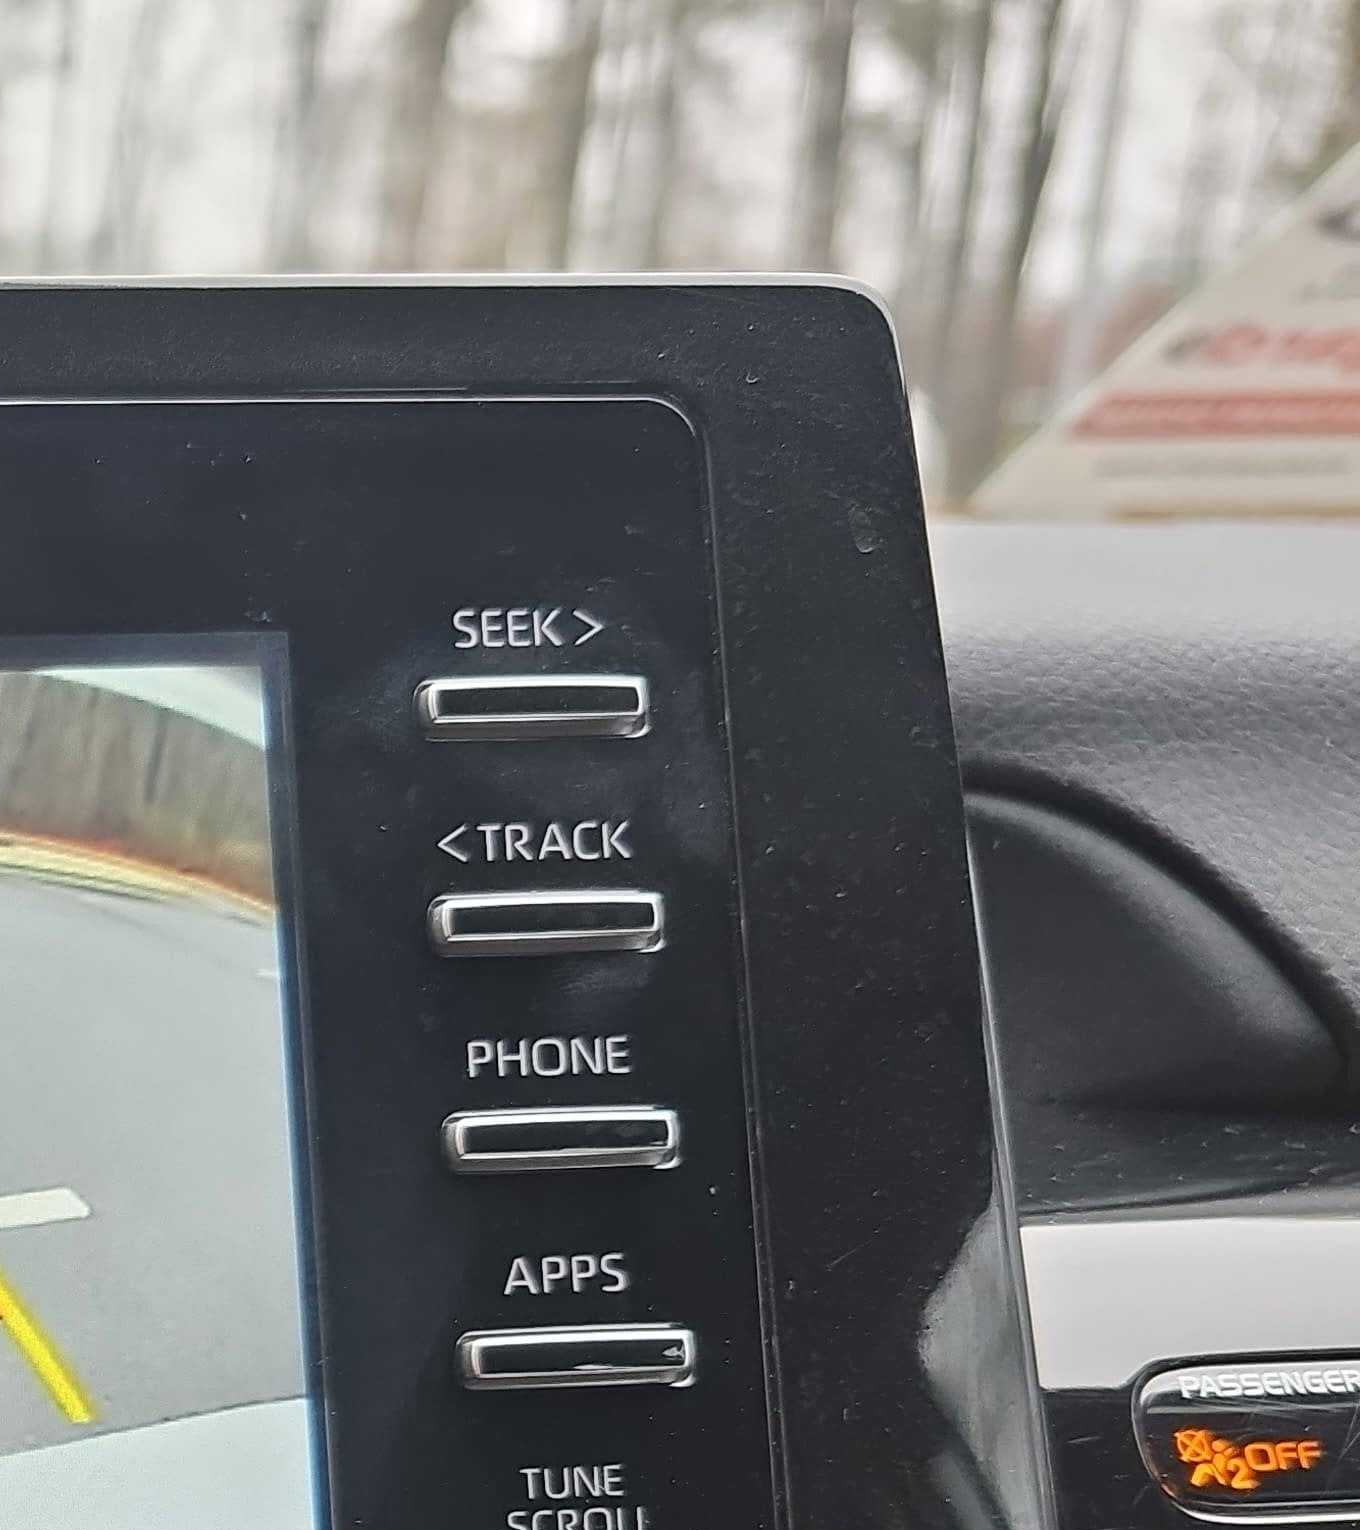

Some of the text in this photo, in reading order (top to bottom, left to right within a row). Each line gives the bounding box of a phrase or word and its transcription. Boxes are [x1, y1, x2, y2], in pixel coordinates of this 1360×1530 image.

[466, 1034, 633, 1078] PHONE
[503, 1252, 630, 1295] APPS
[1178, 1369, 1360, 1399] PASSENGER
[1244, 1440, 1323, 1472] OFF
[519, 1464, 626, 1500] TUNE
